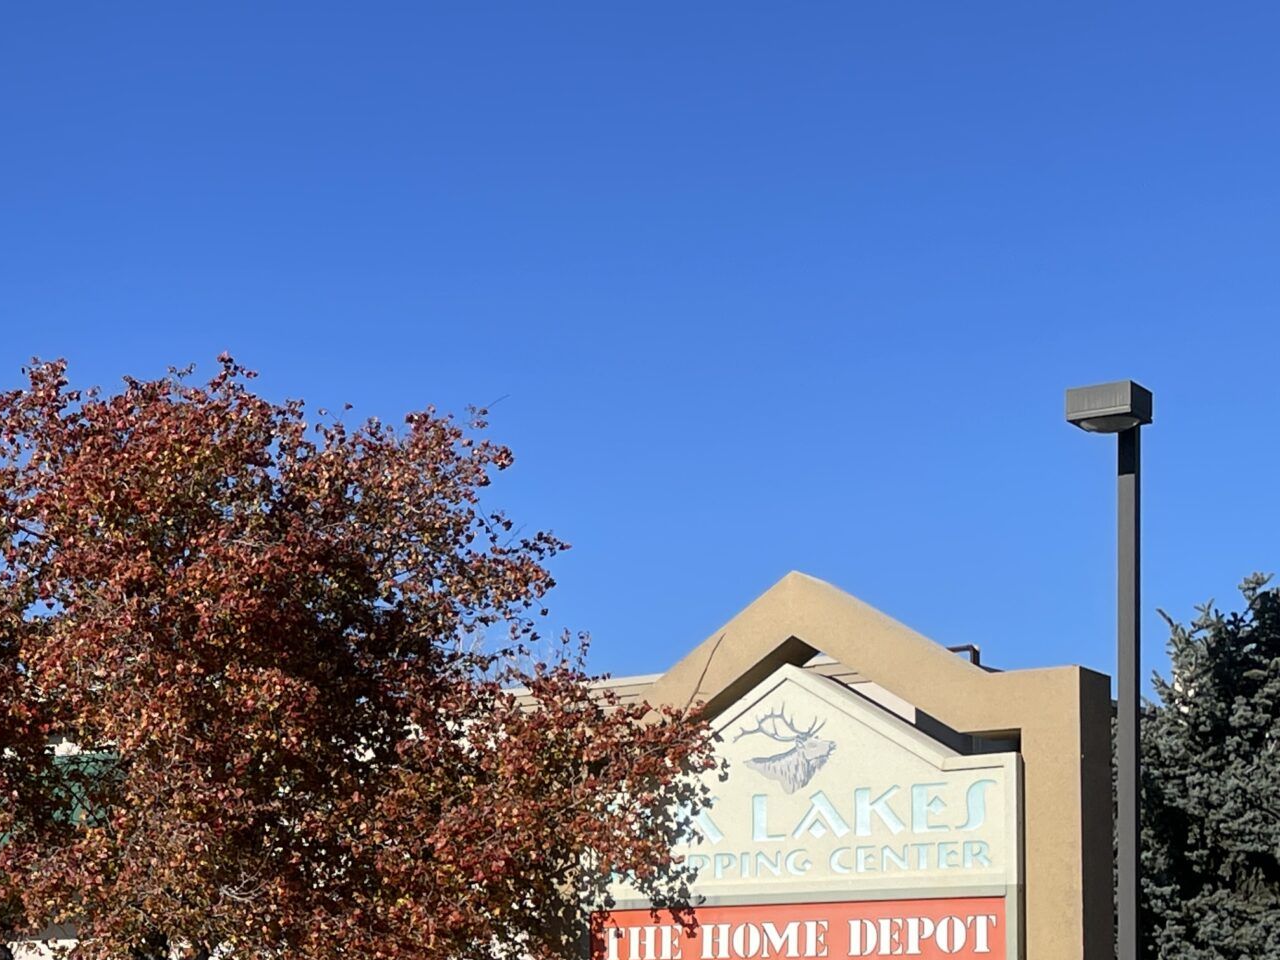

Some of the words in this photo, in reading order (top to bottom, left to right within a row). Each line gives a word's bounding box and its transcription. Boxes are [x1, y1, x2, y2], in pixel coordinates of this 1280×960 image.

[751, 779, 998, 842] LAKES
[829, 840, 993, 874] CENTER
[699, 920, 829, 960] HOME
[847, 914, 998, 957] DEPOT
